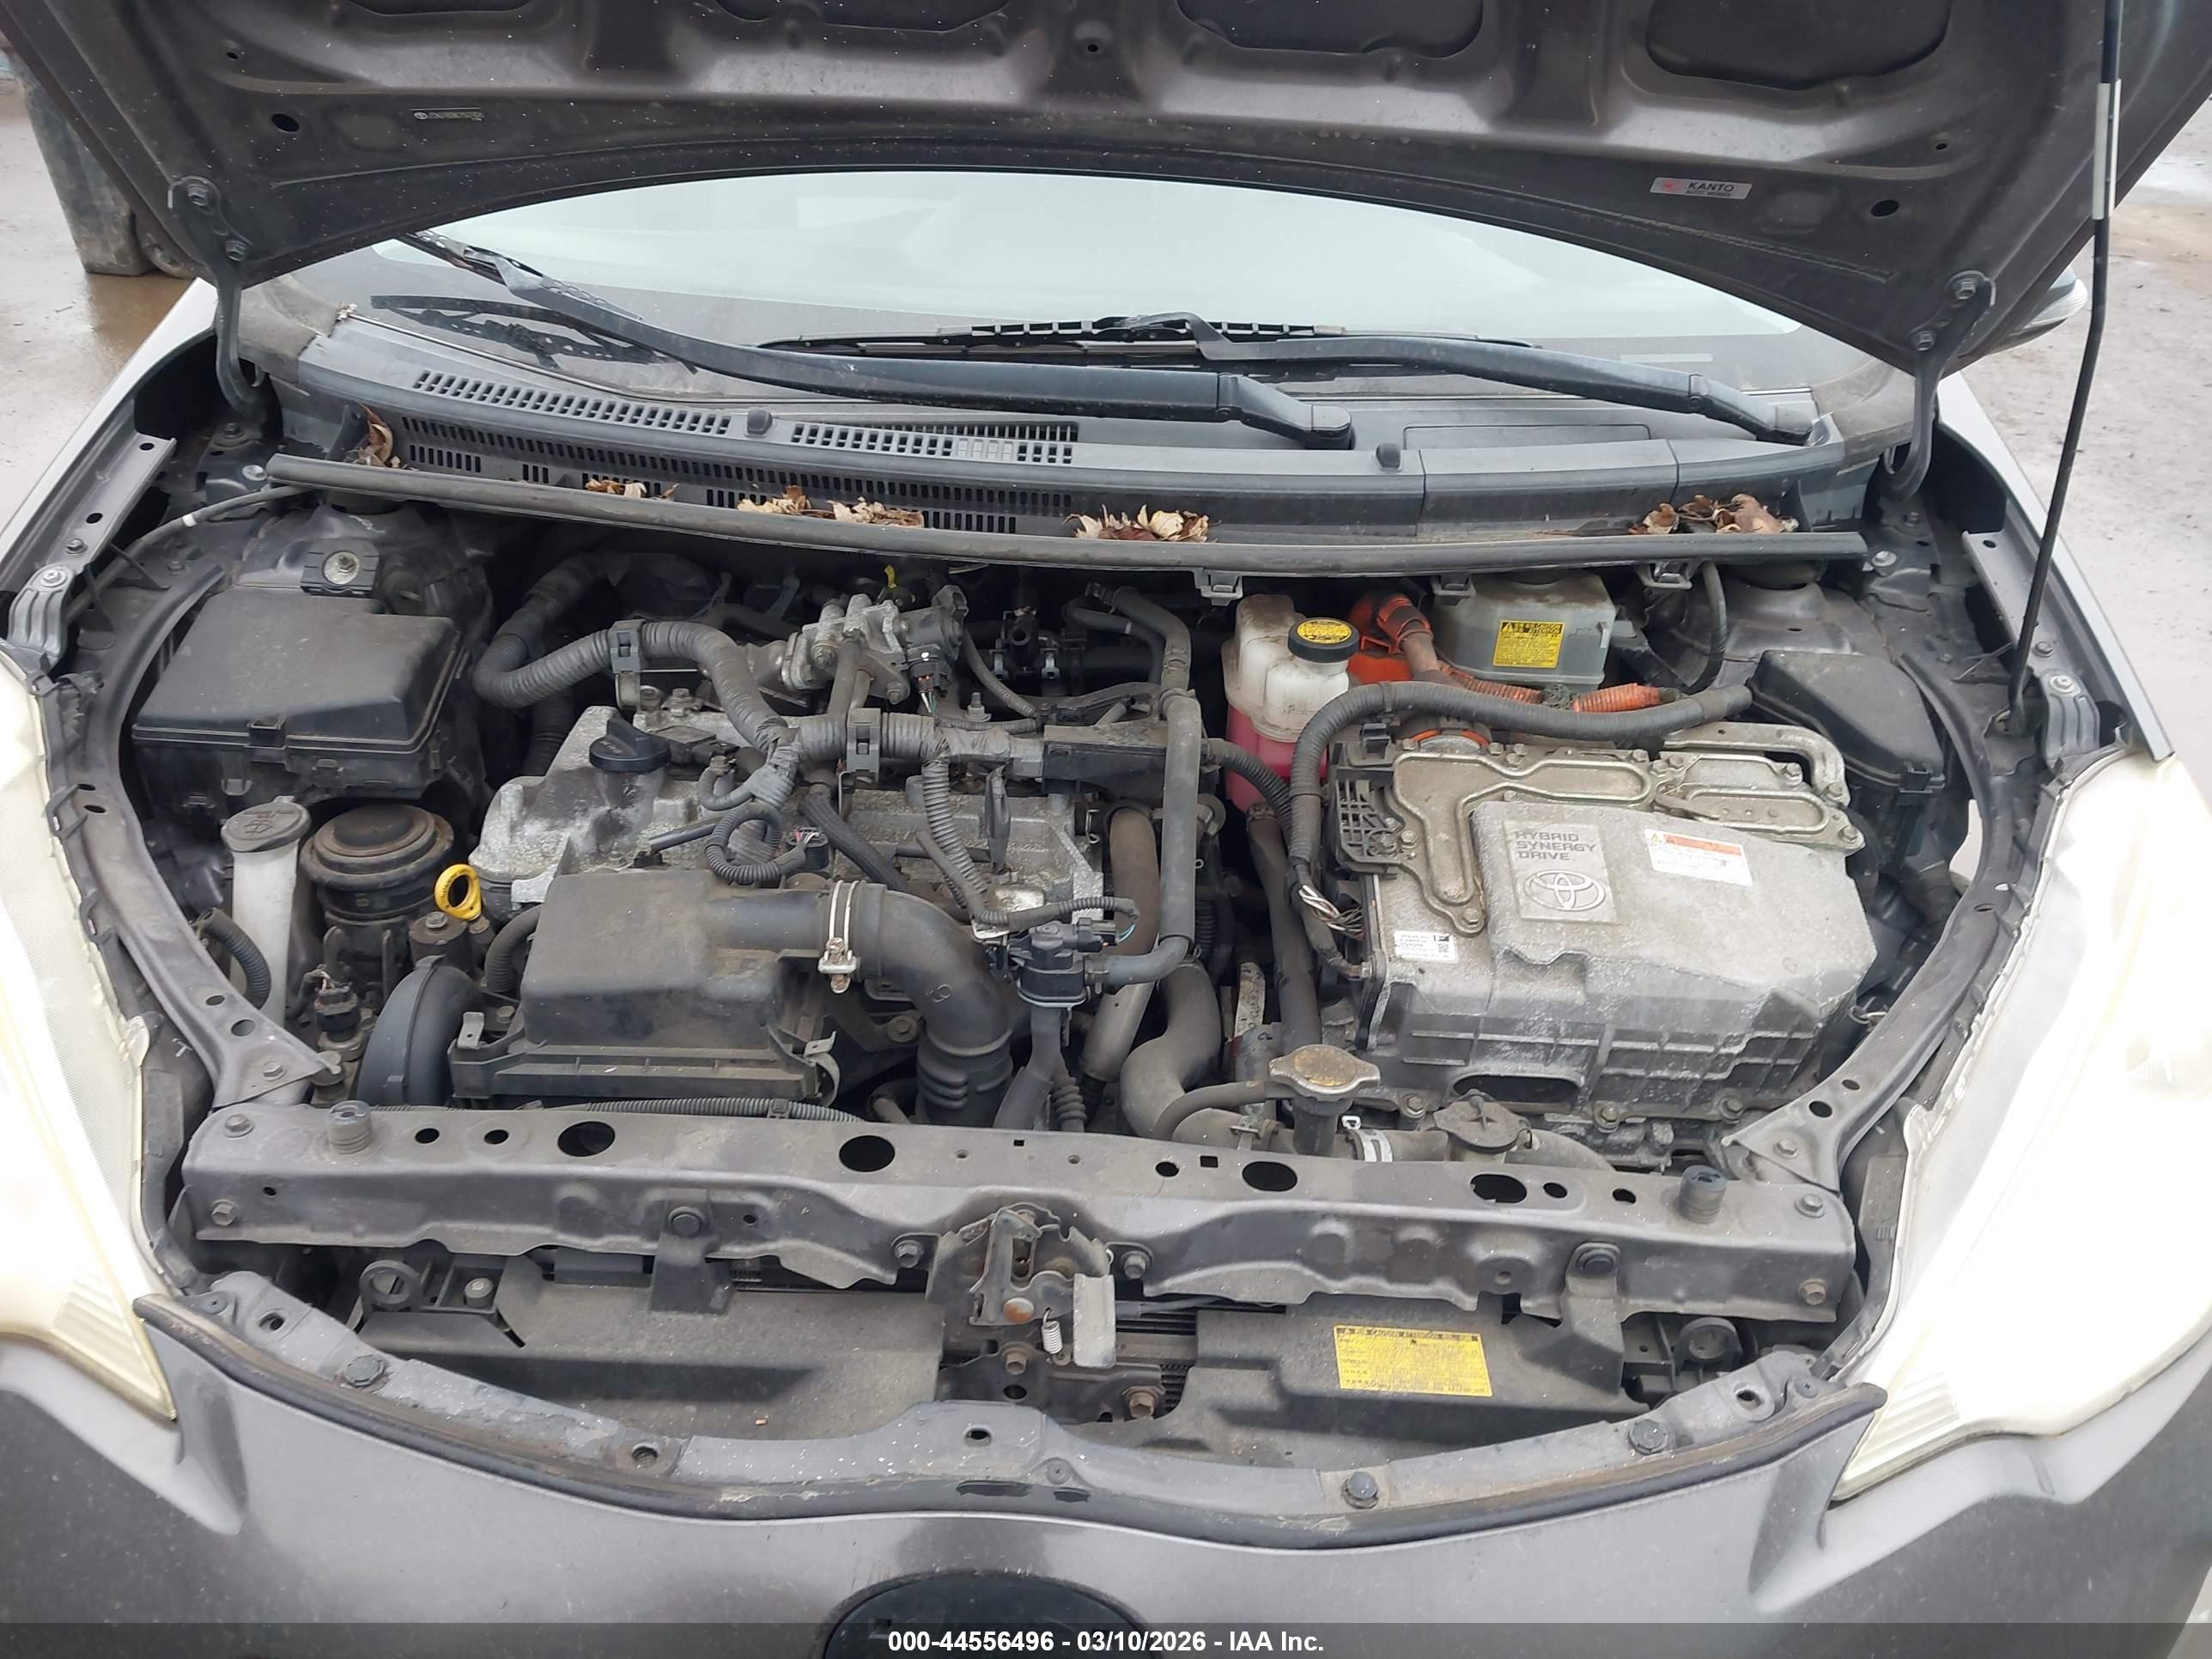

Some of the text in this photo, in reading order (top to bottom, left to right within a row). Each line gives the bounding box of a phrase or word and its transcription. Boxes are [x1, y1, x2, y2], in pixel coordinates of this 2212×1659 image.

[1687, 181, 1735, 191] KANTO
[1515, 830, 1580, 842] HYBRID
[1516, 841, 1596, 853] SYNERGY
[1517, 850, 1571, 861] DRIVE
